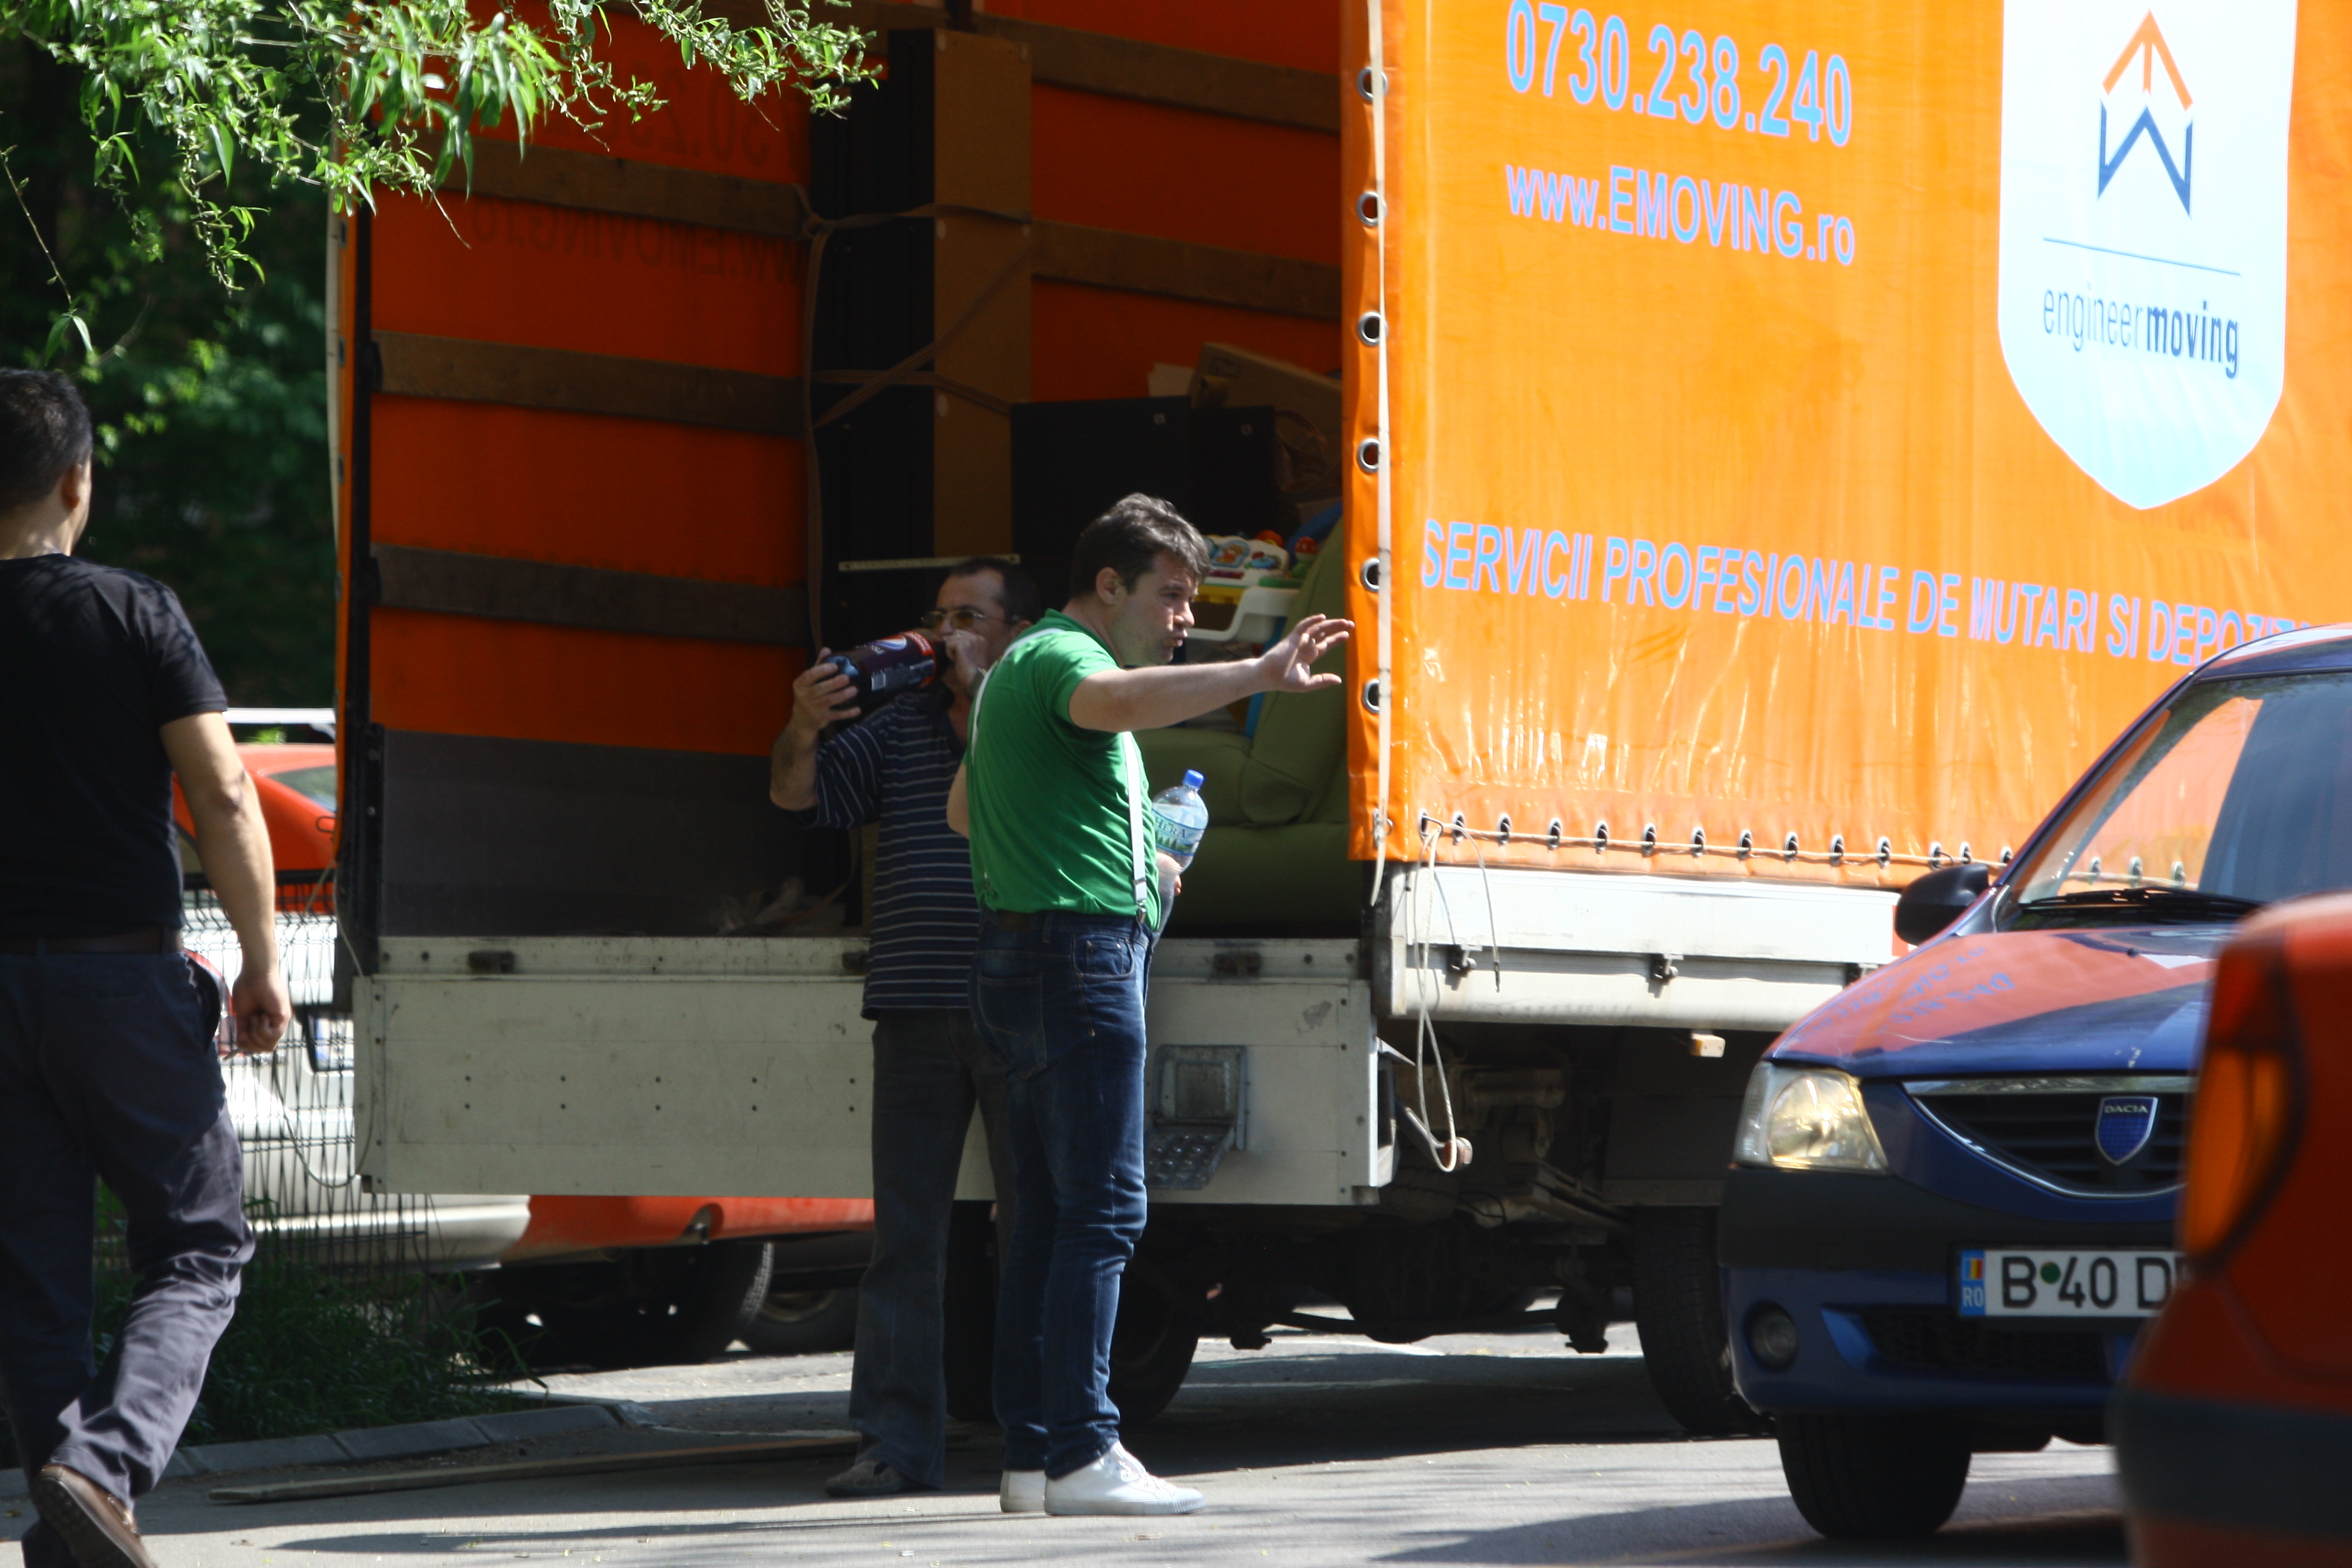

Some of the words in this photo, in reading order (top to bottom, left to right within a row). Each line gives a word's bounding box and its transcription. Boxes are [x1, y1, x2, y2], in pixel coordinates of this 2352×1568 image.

[1506, 0, 1852, 146] 0730.238.240
[1506, 164, 1855, 266] www.EMOVING.ro
[1422, 519, 1592, 599] SERVICII
[1602, 537, 1899, 631] PROFESIONALE
[1907, 570, 1961, 636] DE
[1969, 577, 2099, 653] MUTARI
[2106, 593, 2140, 659] SI
[2149, 601, 2311, 667] DEPO
[2104, 1105, 2149, 1113] DACIA
[1962, 1286, 1985, 1308] RO
[2002, 1256, 2036, 1308] B
[2059, 1256, 2117, 1309] 40
[2136, 1257, 2184, 1310] D
